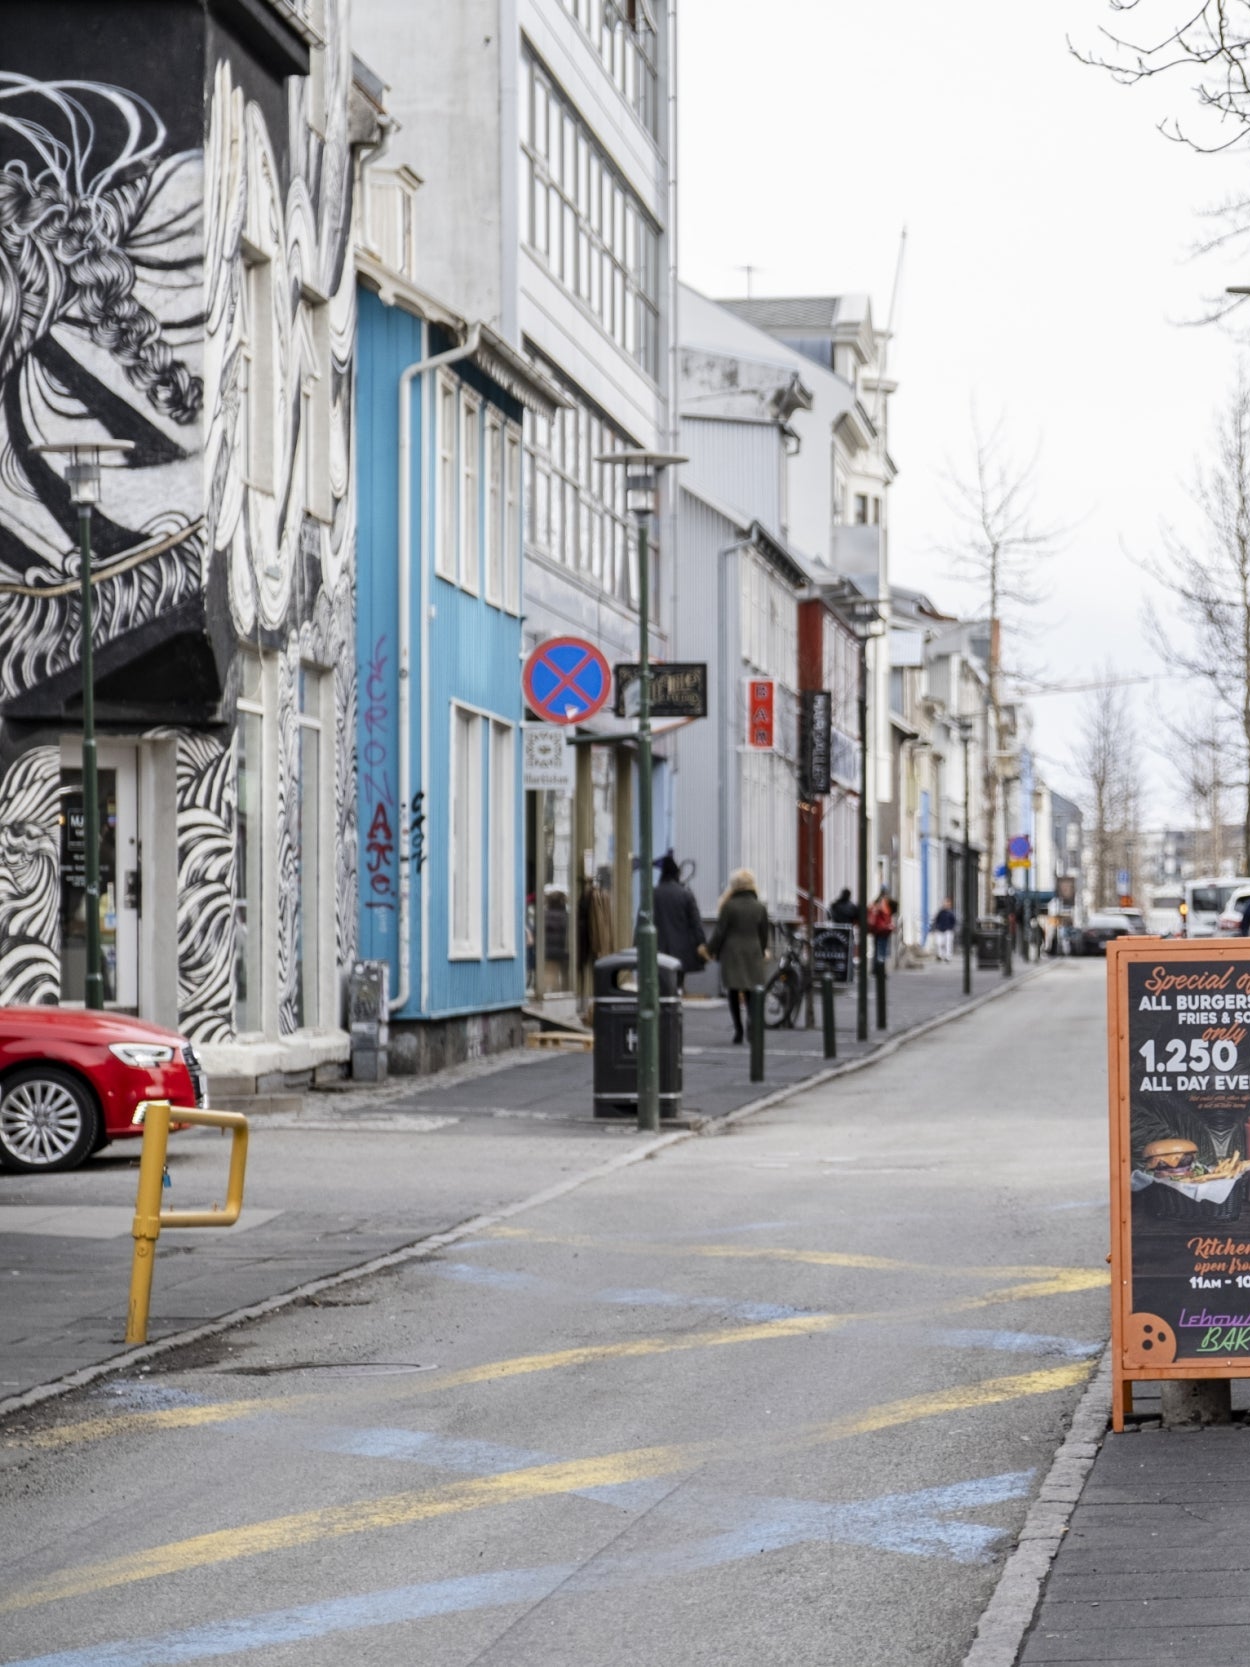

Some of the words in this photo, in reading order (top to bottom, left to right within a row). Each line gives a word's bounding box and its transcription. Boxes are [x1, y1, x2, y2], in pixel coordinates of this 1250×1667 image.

[1145, 966, 1235, 996] Special
[1139, 995, 1172, 1011] ALL
[1178, 1012, 1218, 1025] FRIES
[1221, 1012, 1230, 1024] &
[1201, 1022, 1247, 1045] only
[1138, 1038, 1238, 1073] 1.250
[1139, 1076, 1172, 1092] ALL
[1177, 1076, 1210, 1091] DAY
[1194, 1261, 1228, 1276] open
[1189, 1276, 1221, 1289] 11AM
